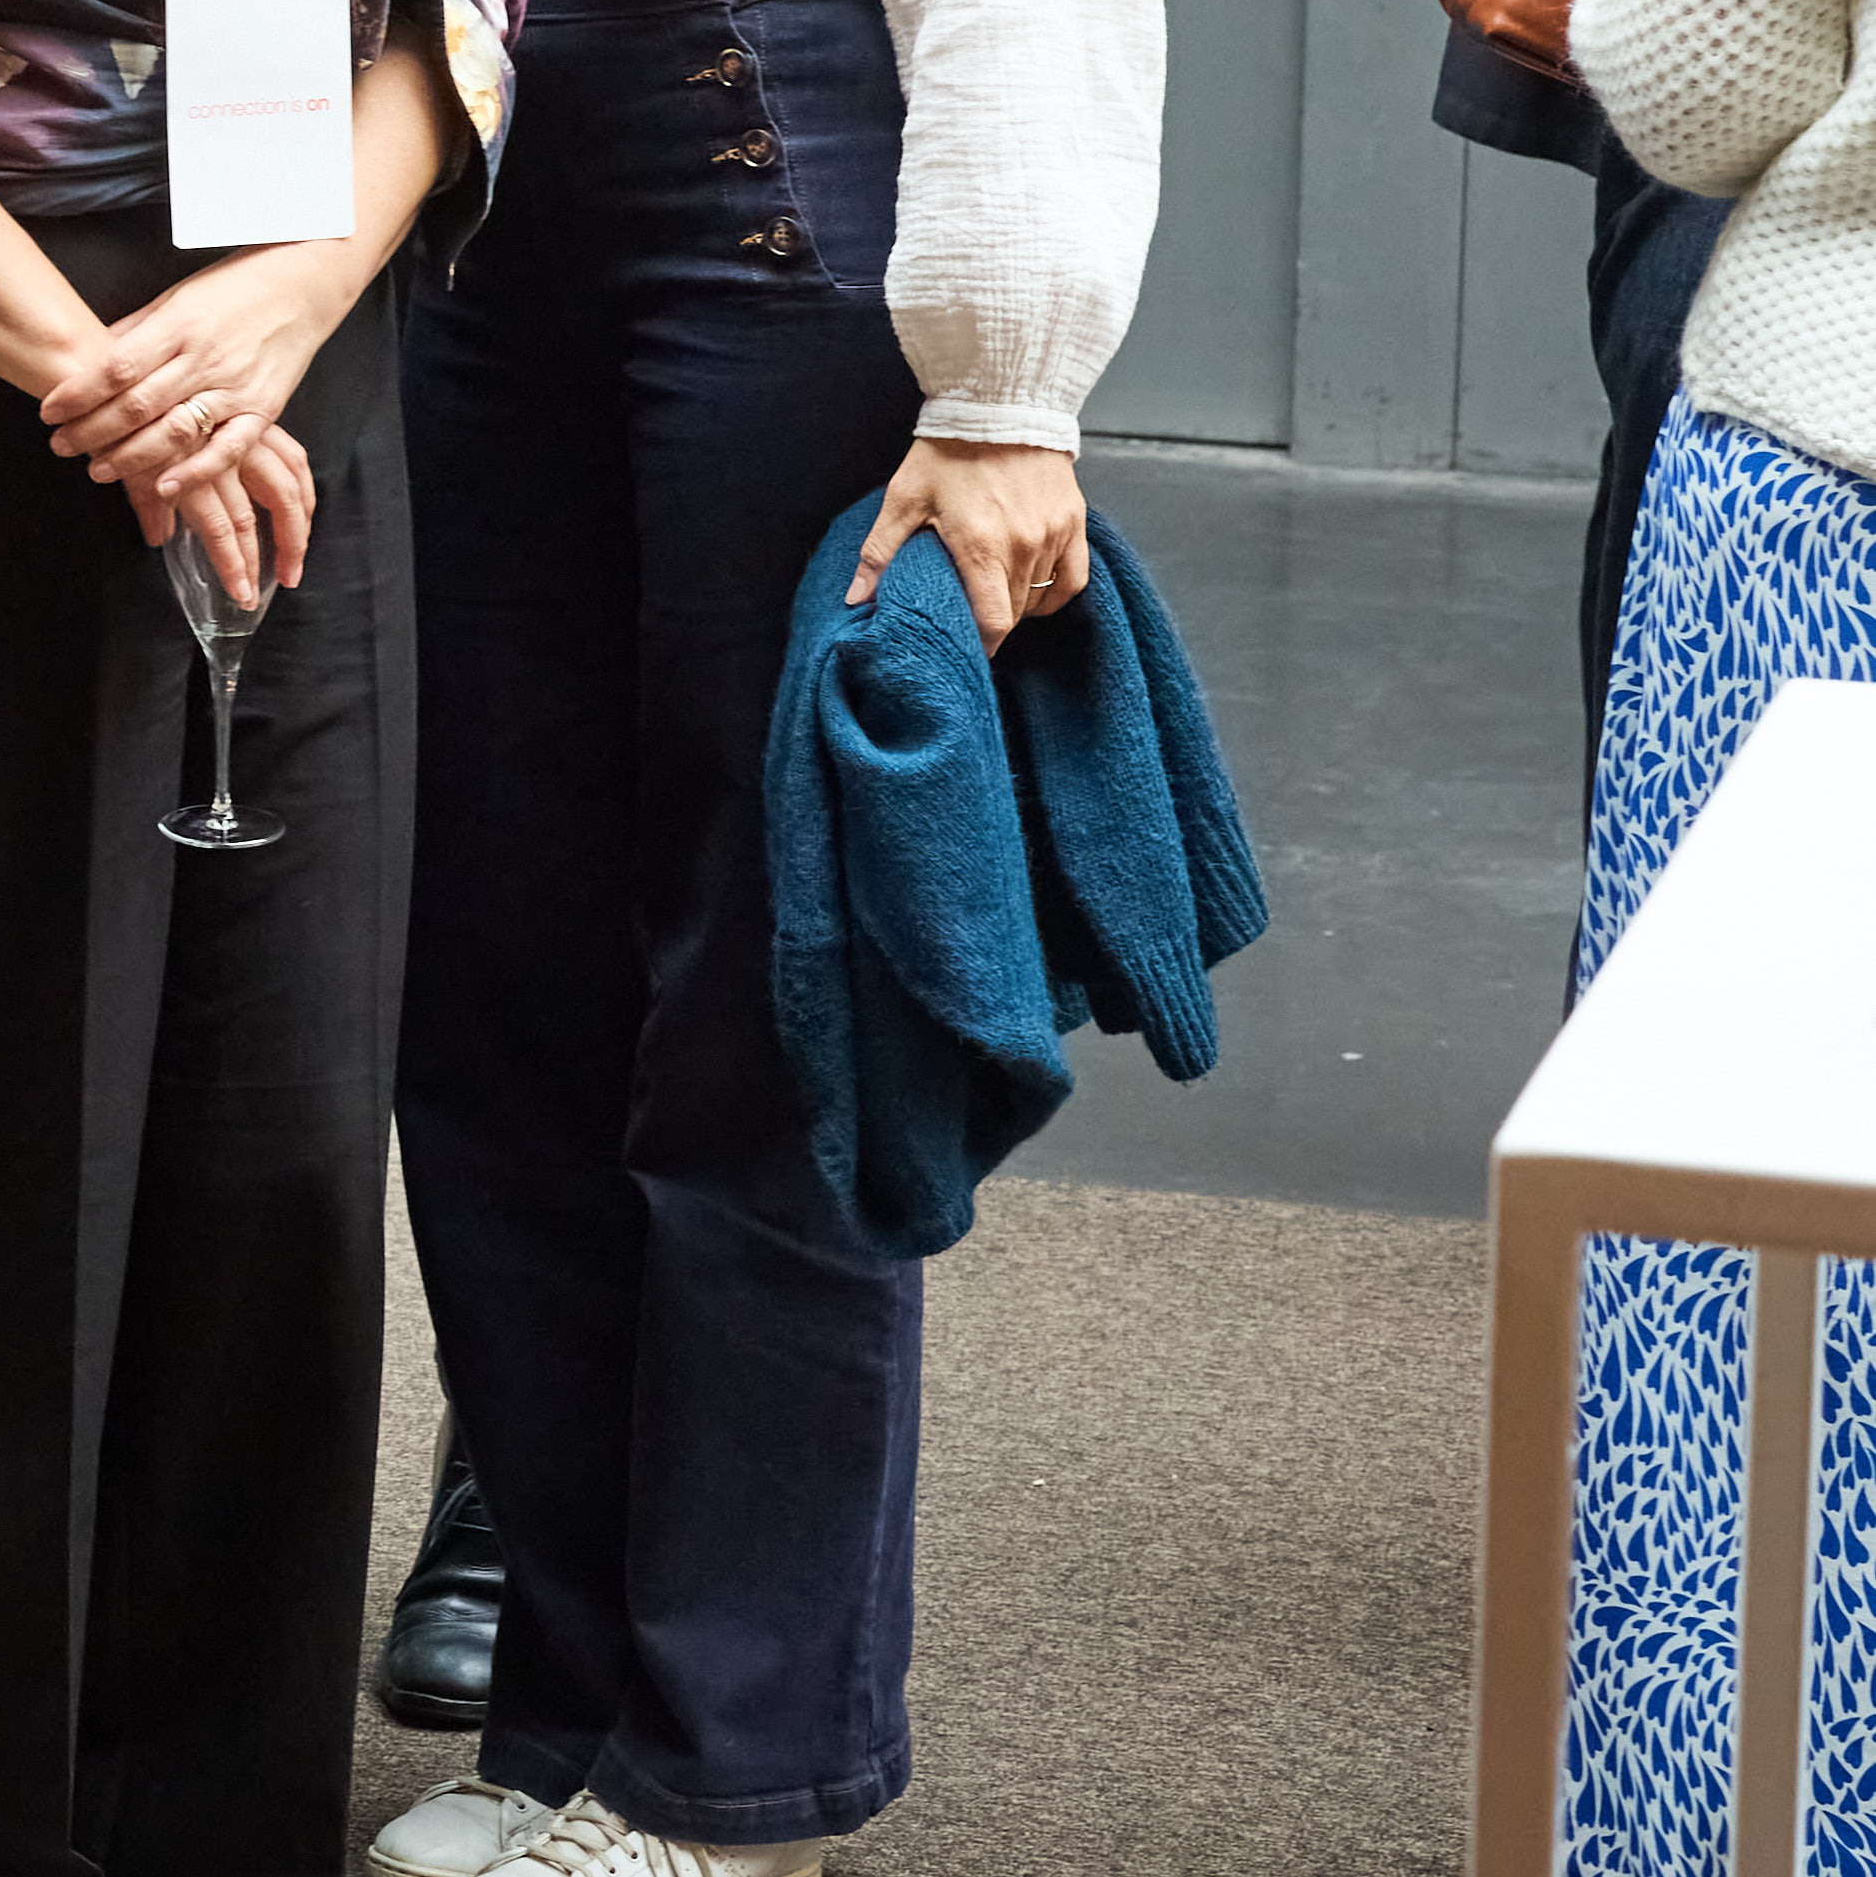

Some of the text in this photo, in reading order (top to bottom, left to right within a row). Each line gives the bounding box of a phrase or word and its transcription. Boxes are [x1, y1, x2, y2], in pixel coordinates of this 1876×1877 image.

[189, 95, 330, 119] connection is on
